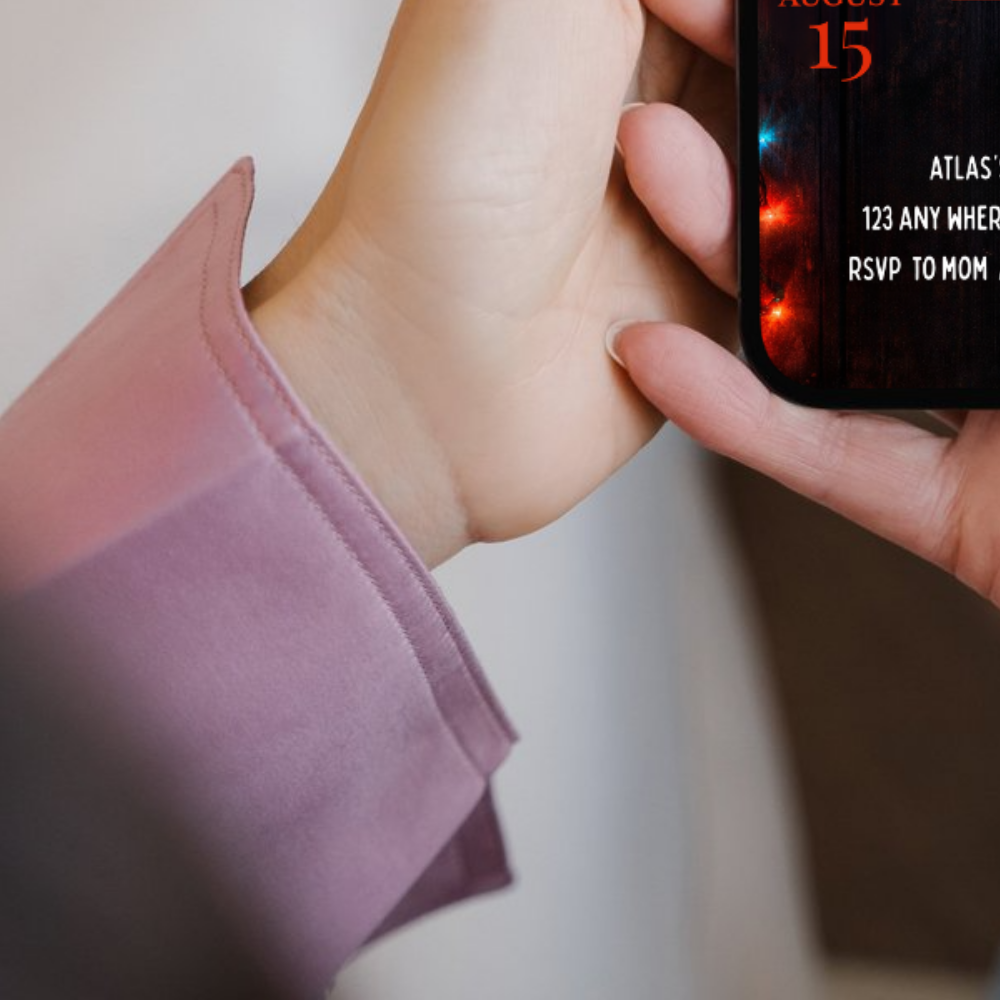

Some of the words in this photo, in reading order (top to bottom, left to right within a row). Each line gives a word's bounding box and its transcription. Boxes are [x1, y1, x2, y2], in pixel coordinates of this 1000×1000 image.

[809, 18, 873, 83] 15
[862, 205, 893, 231] 123
[899, 205, 941, 231] ANY
[848, 256, 902, 281] RSVP
[912, 256, 936, 281] TO
[942, 255, 988, 281] MOM
